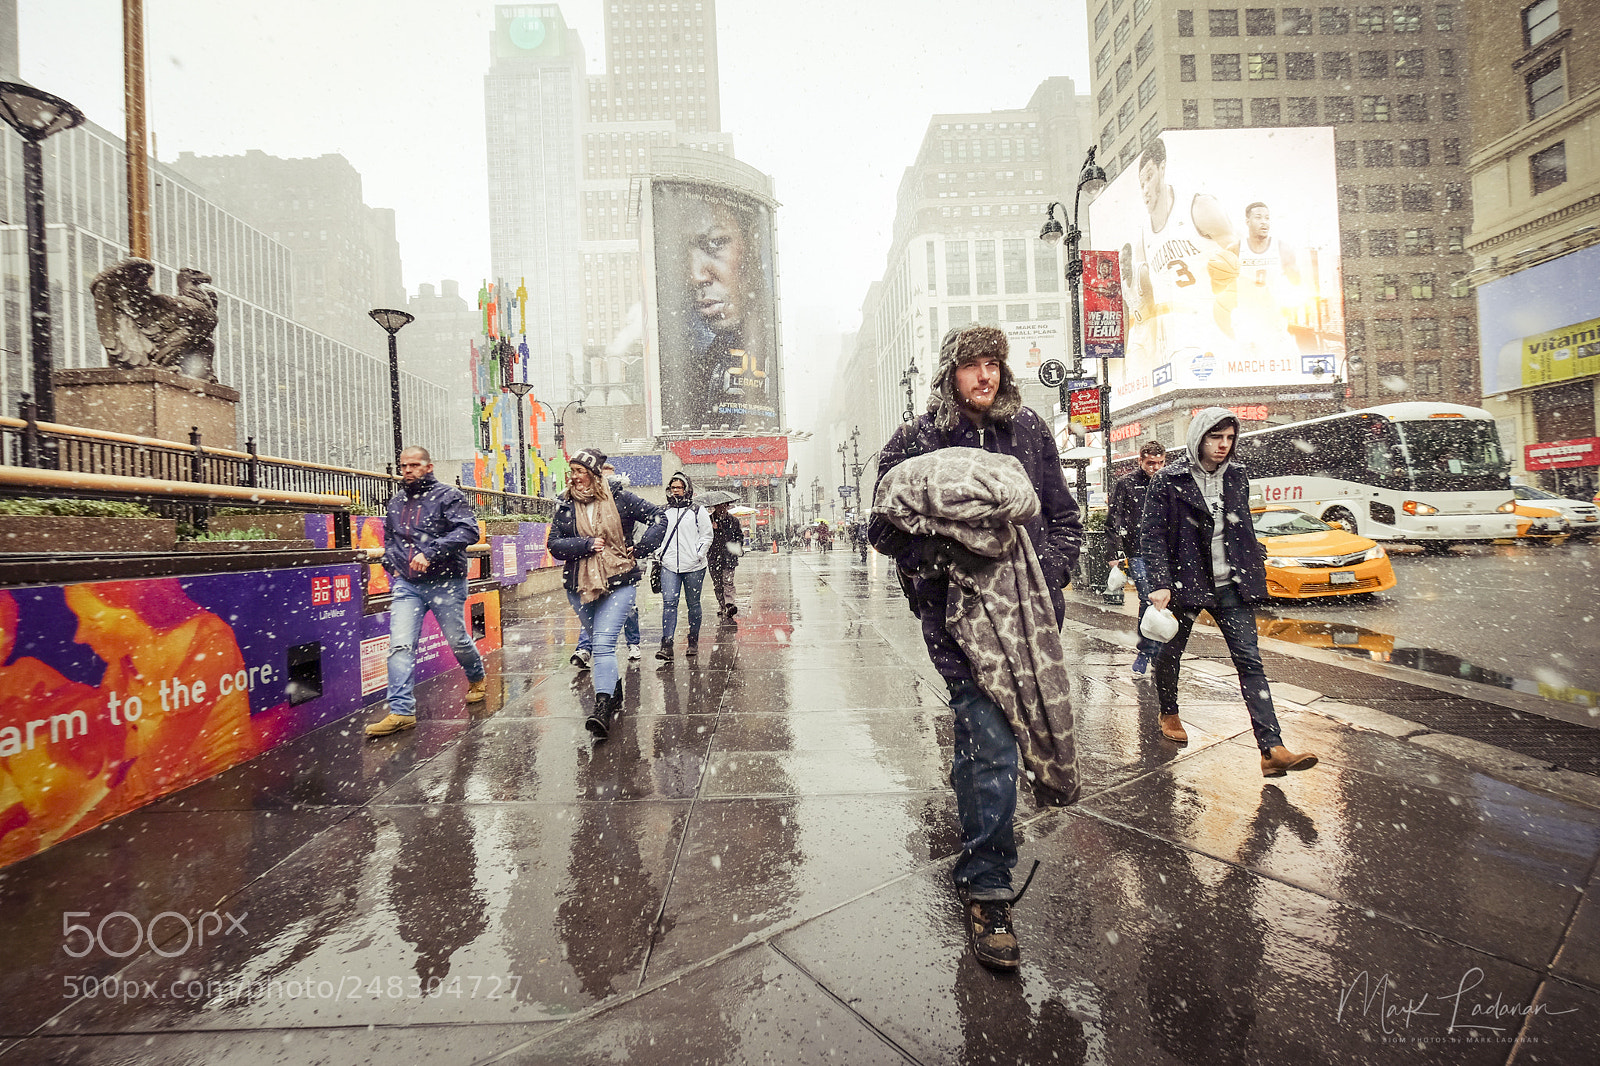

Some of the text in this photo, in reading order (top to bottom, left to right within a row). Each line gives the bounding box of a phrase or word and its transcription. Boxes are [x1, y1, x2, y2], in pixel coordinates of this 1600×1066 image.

[1151, 239, 1201, 274] VILLANOVA
[1167, 259, 1196, 288] 3
[1088, 311, 1122, 320] WE ARE
[1087, 326, 1120, 337] TEAM
[724, 348, 770, 399] 24
[1228, 360, 1265, 374] MARCH
[733, 377, 764, 389] LEGACY
[1153, 365, 1171, 386] FS1
[1117, 381, 1135, 397] MARCH
[690, 446, 709, 456] Bank
[716, 460, 784, 477] Subway
[0, 663, 279, 757] arm to the core.
